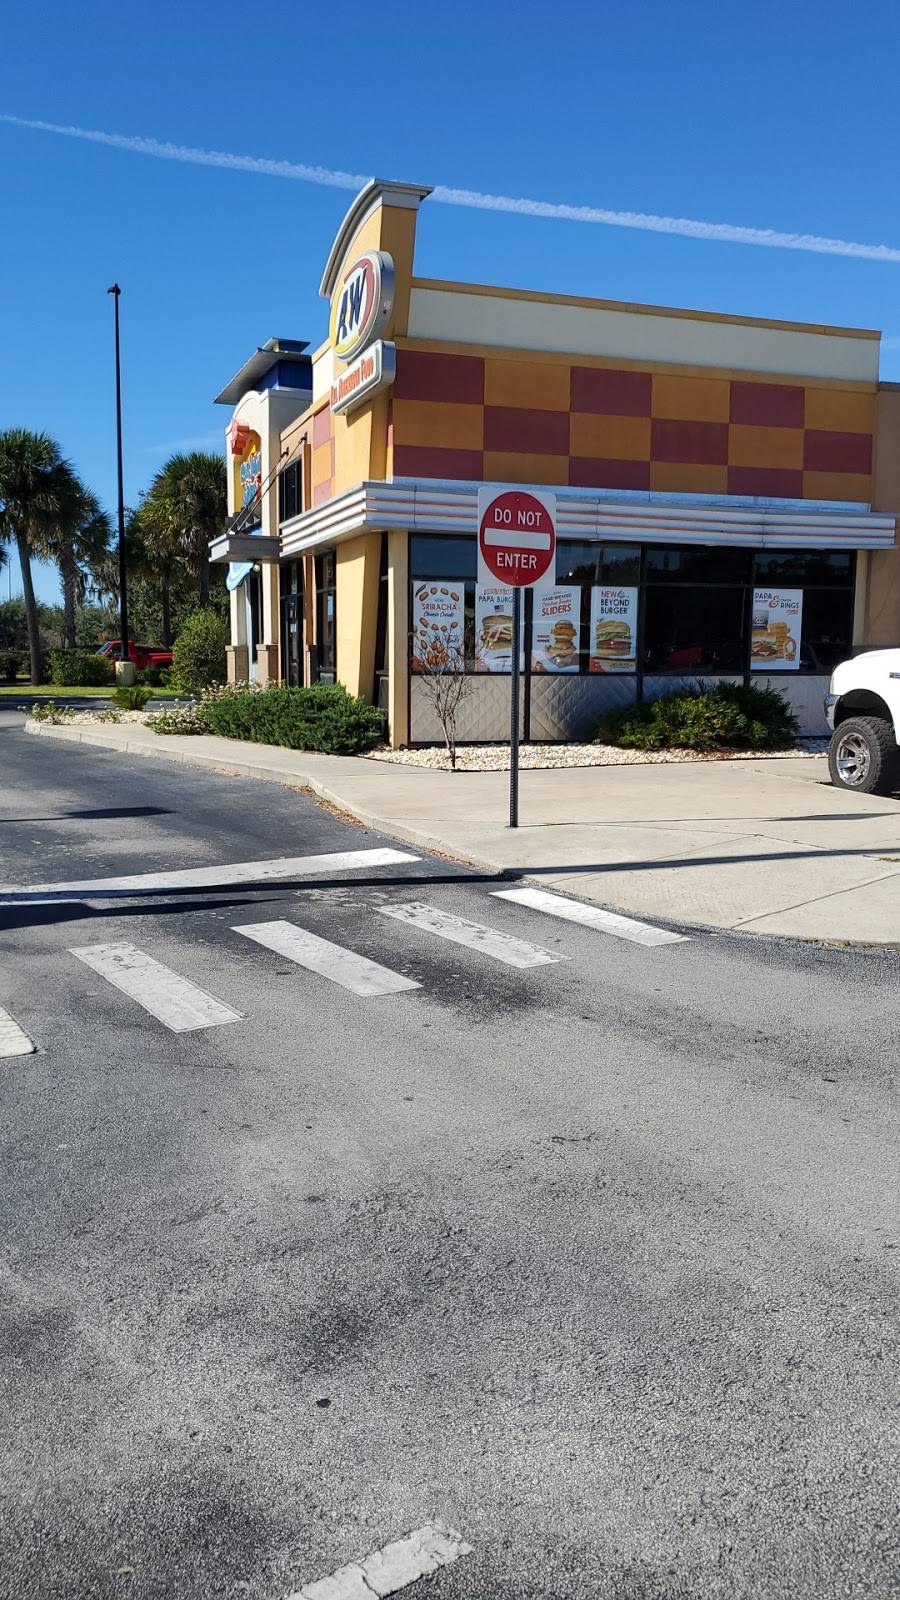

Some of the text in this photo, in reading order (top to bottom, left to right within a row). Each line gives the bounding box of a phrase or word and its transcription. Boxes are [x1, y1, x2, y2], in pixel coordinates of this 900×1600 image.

[494, 508, 542, 527] DO NOT
[496, 552, 537, 569] ENTER
[478, 595, 513, 603] PAPA BURG
[600, 598, 630, 607] BEYOND
[755, 592, 773, 600] PAPA
[768, 595, 779, 608] &
[422, 602, 457, 611] SRIRACHA
[541, 603, 572, 617] SLIDERS
[600, 606, 628, 615] BURGER
